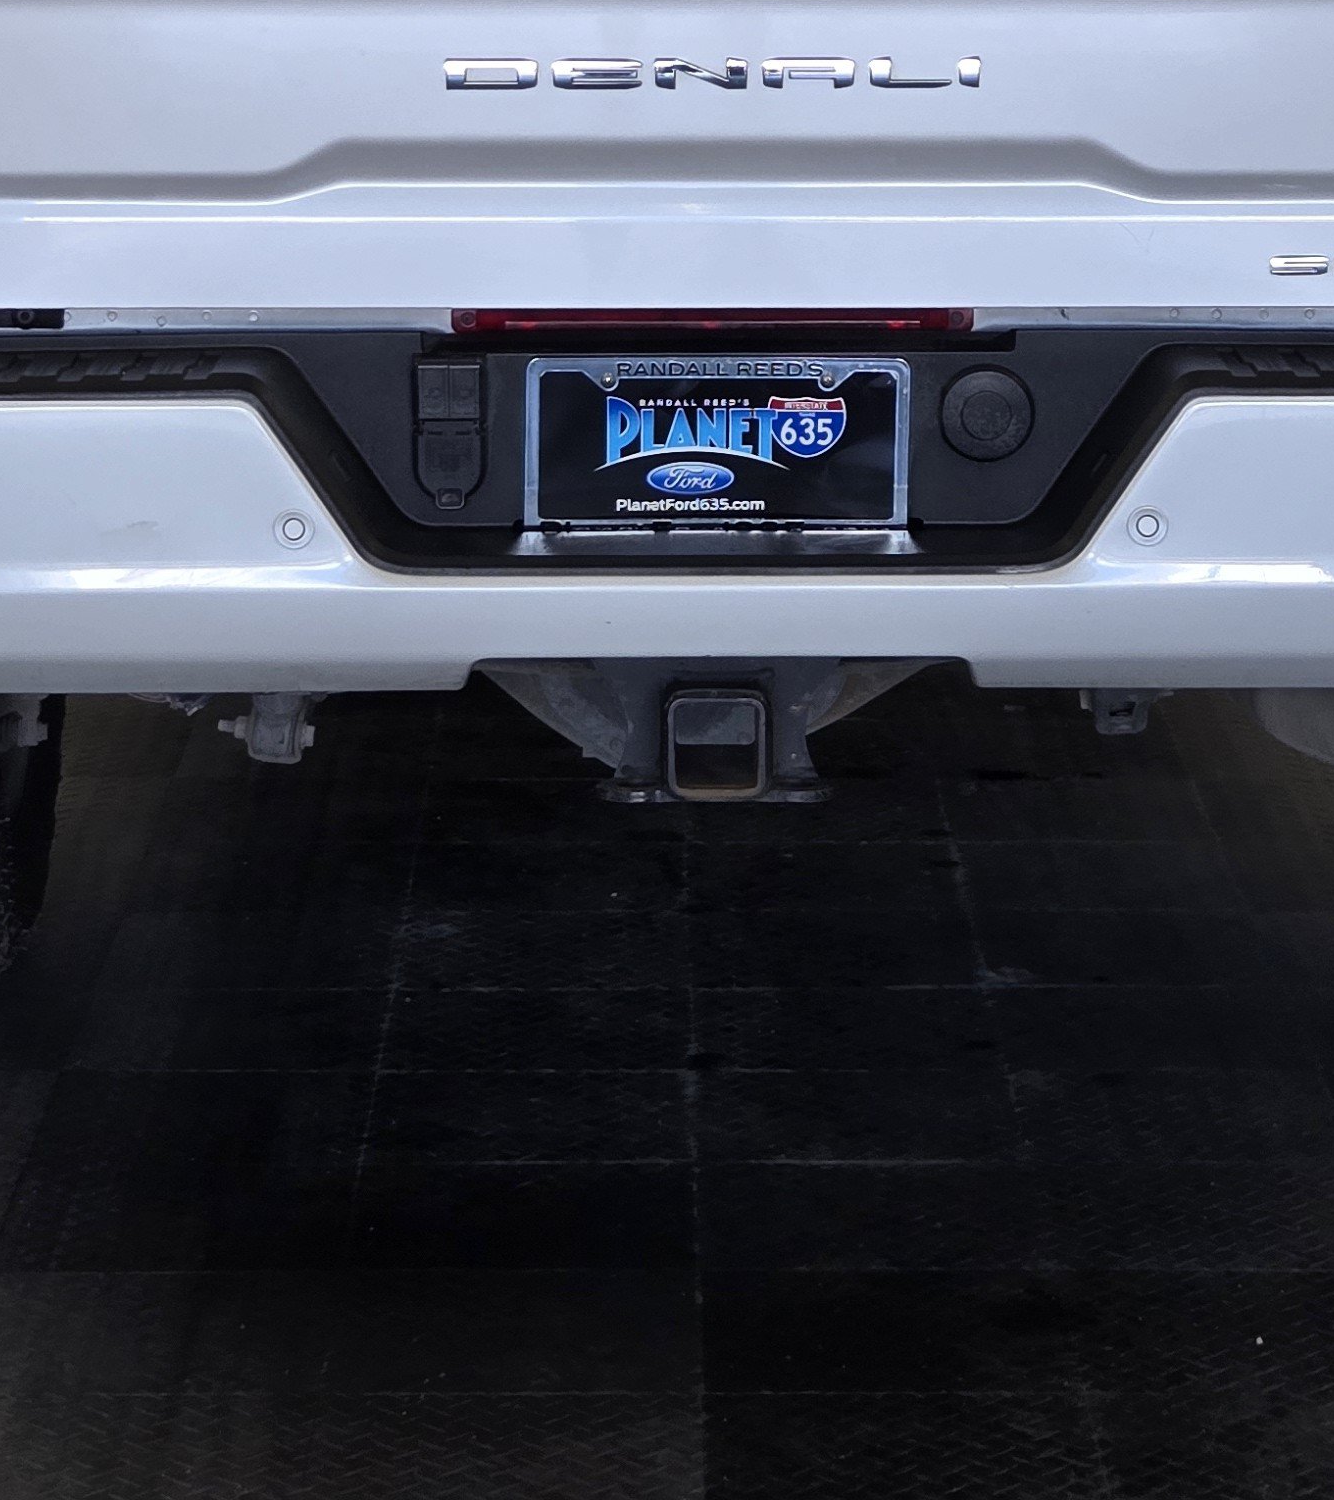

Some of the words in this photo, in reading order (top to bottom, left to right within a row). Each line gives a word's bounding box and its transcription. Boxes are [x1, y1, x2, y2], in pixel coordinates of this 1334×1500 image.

[443, 57, 982, 90] DENALI
[617, 361, 728, 377] RANDALL
[736, 361, 824, 377] REED'S
[639, 399, 697, 407] RANDALL
[606, 396, 778, 464] PLANET
[780, 417, 834, 446] 635
[663, 468, 717, 490] Ford
[616, 498, 766, 512] PlanetFord635.com
